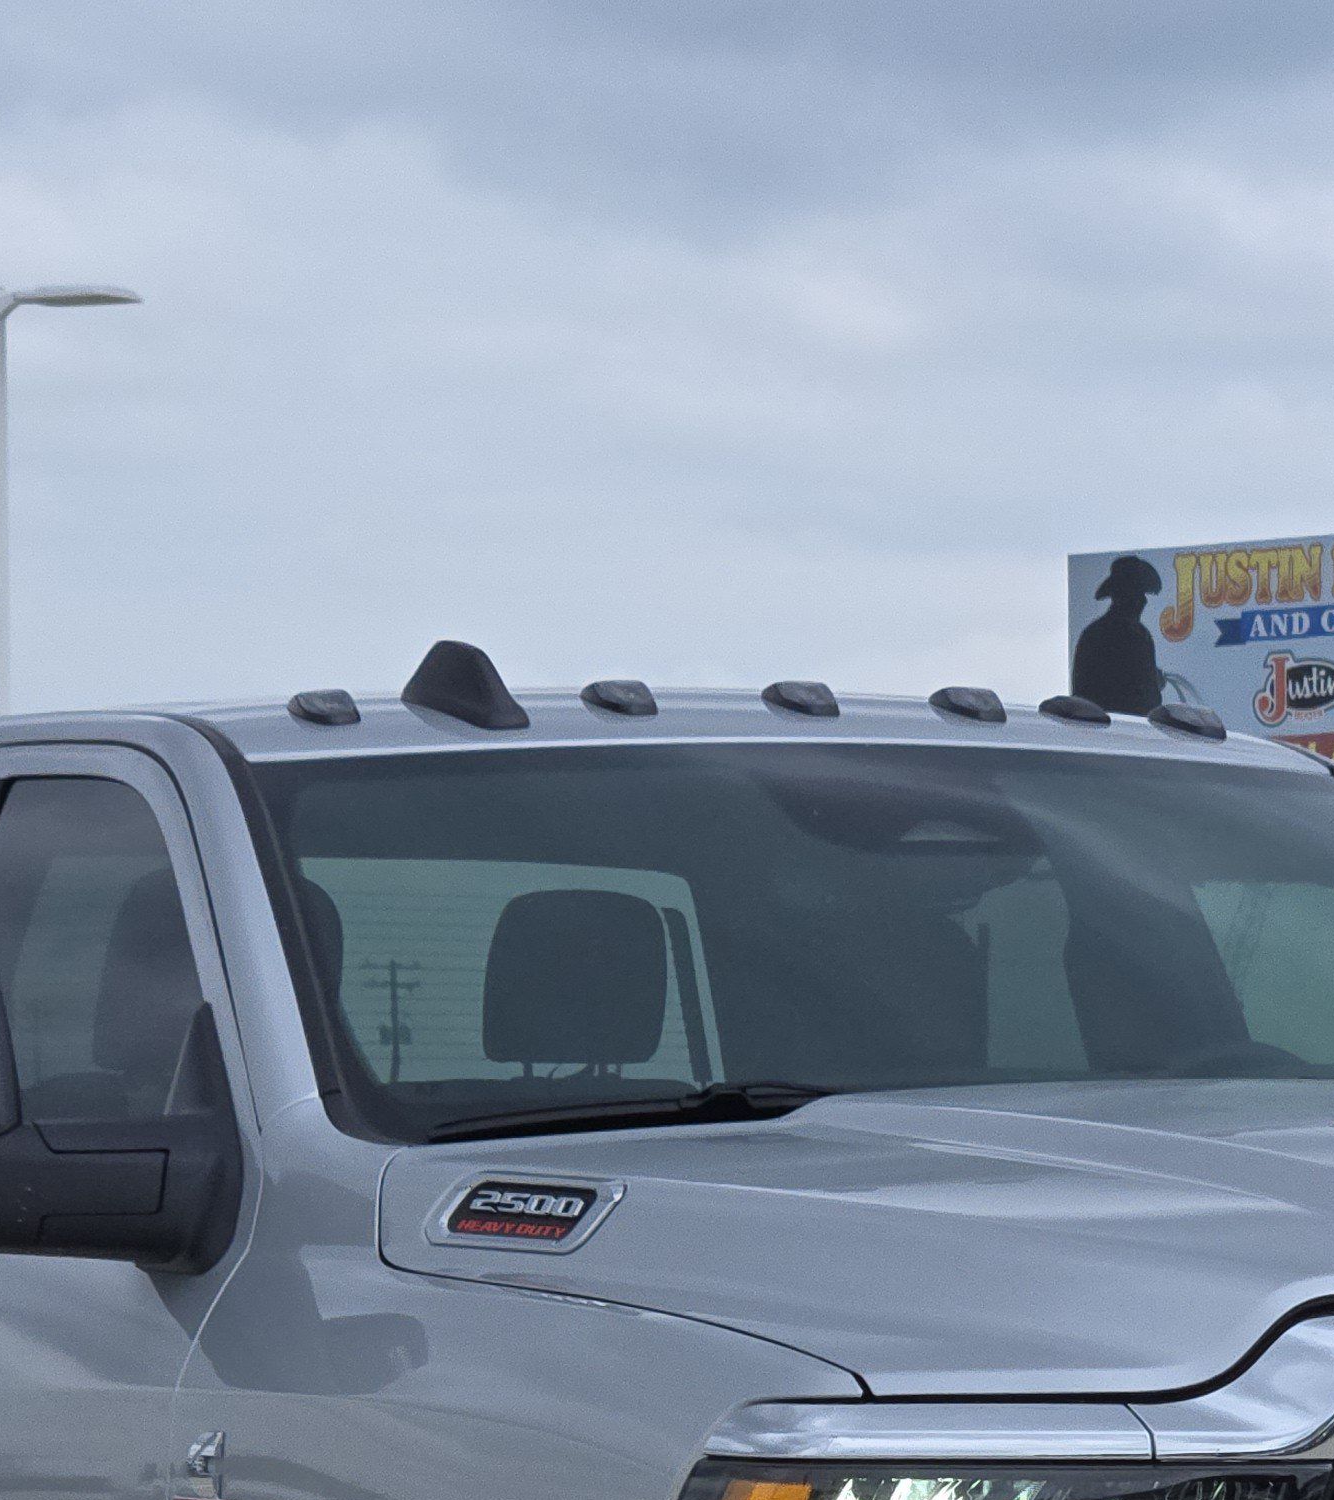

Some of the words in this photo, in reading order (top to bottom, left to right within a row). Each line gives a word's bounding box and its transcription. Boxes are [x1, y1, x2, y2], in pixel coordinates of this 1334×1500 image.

[1159, 544, 1323, 642] JUSTIN
[1249, 611, 1311, 639] AND
[469, 1190, 585, 1218] 2500
[457, 1220, 515, 1234] HEAVY
[515, 1223, 566, 1238] DUTY
